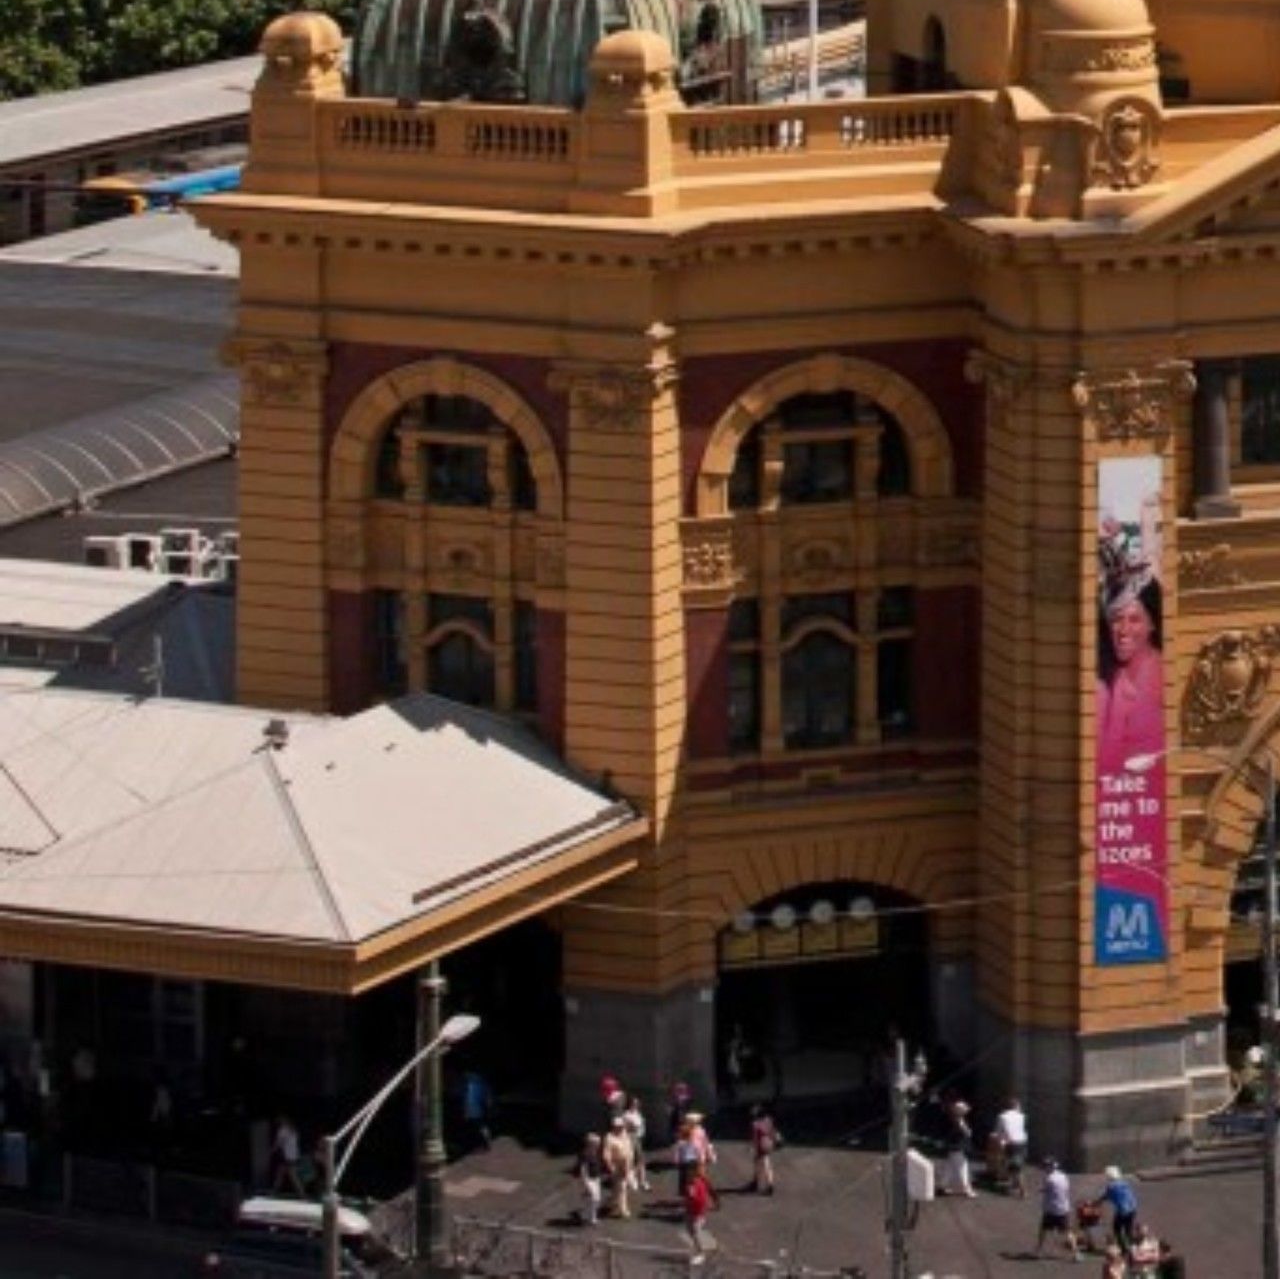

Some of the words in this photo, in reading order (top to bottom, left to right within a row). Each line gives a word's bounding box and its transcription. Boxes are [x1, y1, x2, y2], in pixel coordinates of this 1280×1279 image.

[1099, 775, 1147, 795] Take
[1099, 800, 1132, 819] me
[1137, 797, 1160, 816] to
[1100, 821, 1134, 842] the
